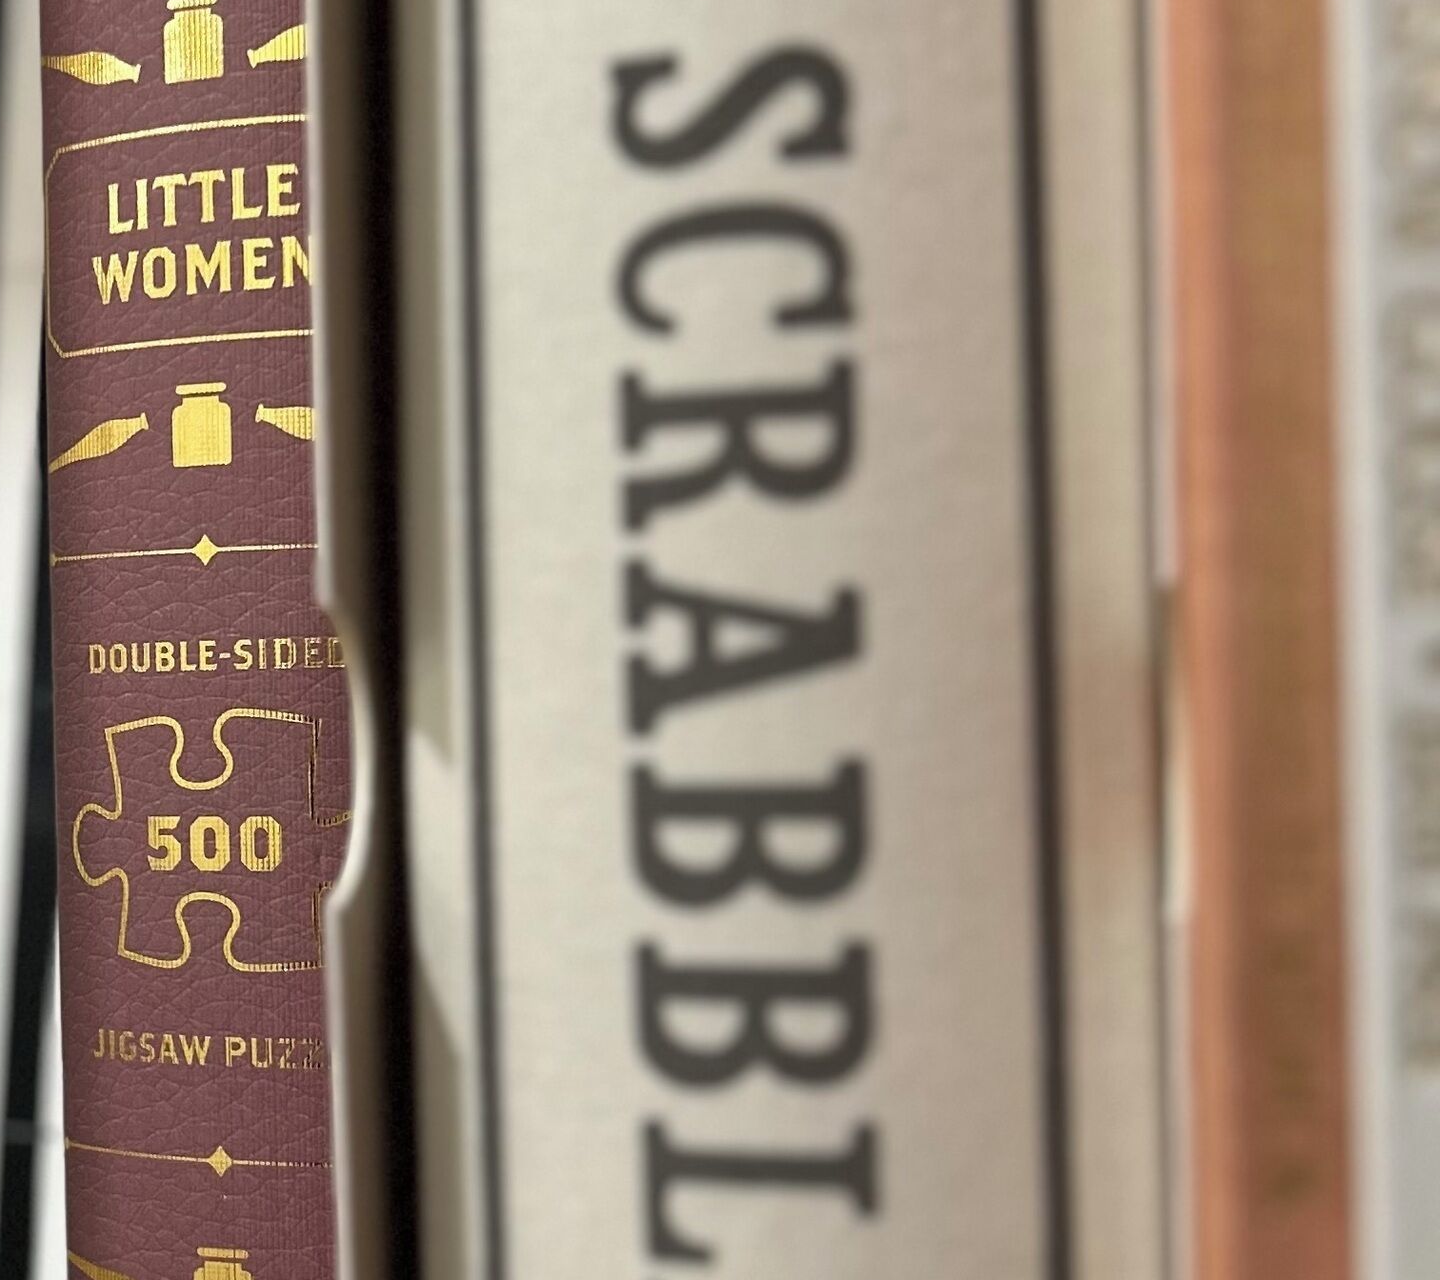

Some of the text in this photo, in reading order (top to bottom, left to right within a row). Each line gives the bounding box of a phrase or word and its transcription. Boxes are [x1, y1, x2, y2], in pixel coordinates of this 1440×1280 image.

[107, 163, 301, 234] LITTLE
[147, 815, 282, 872] 500
[93, 1028, 326, 1070] JIGSAW PUZZ
